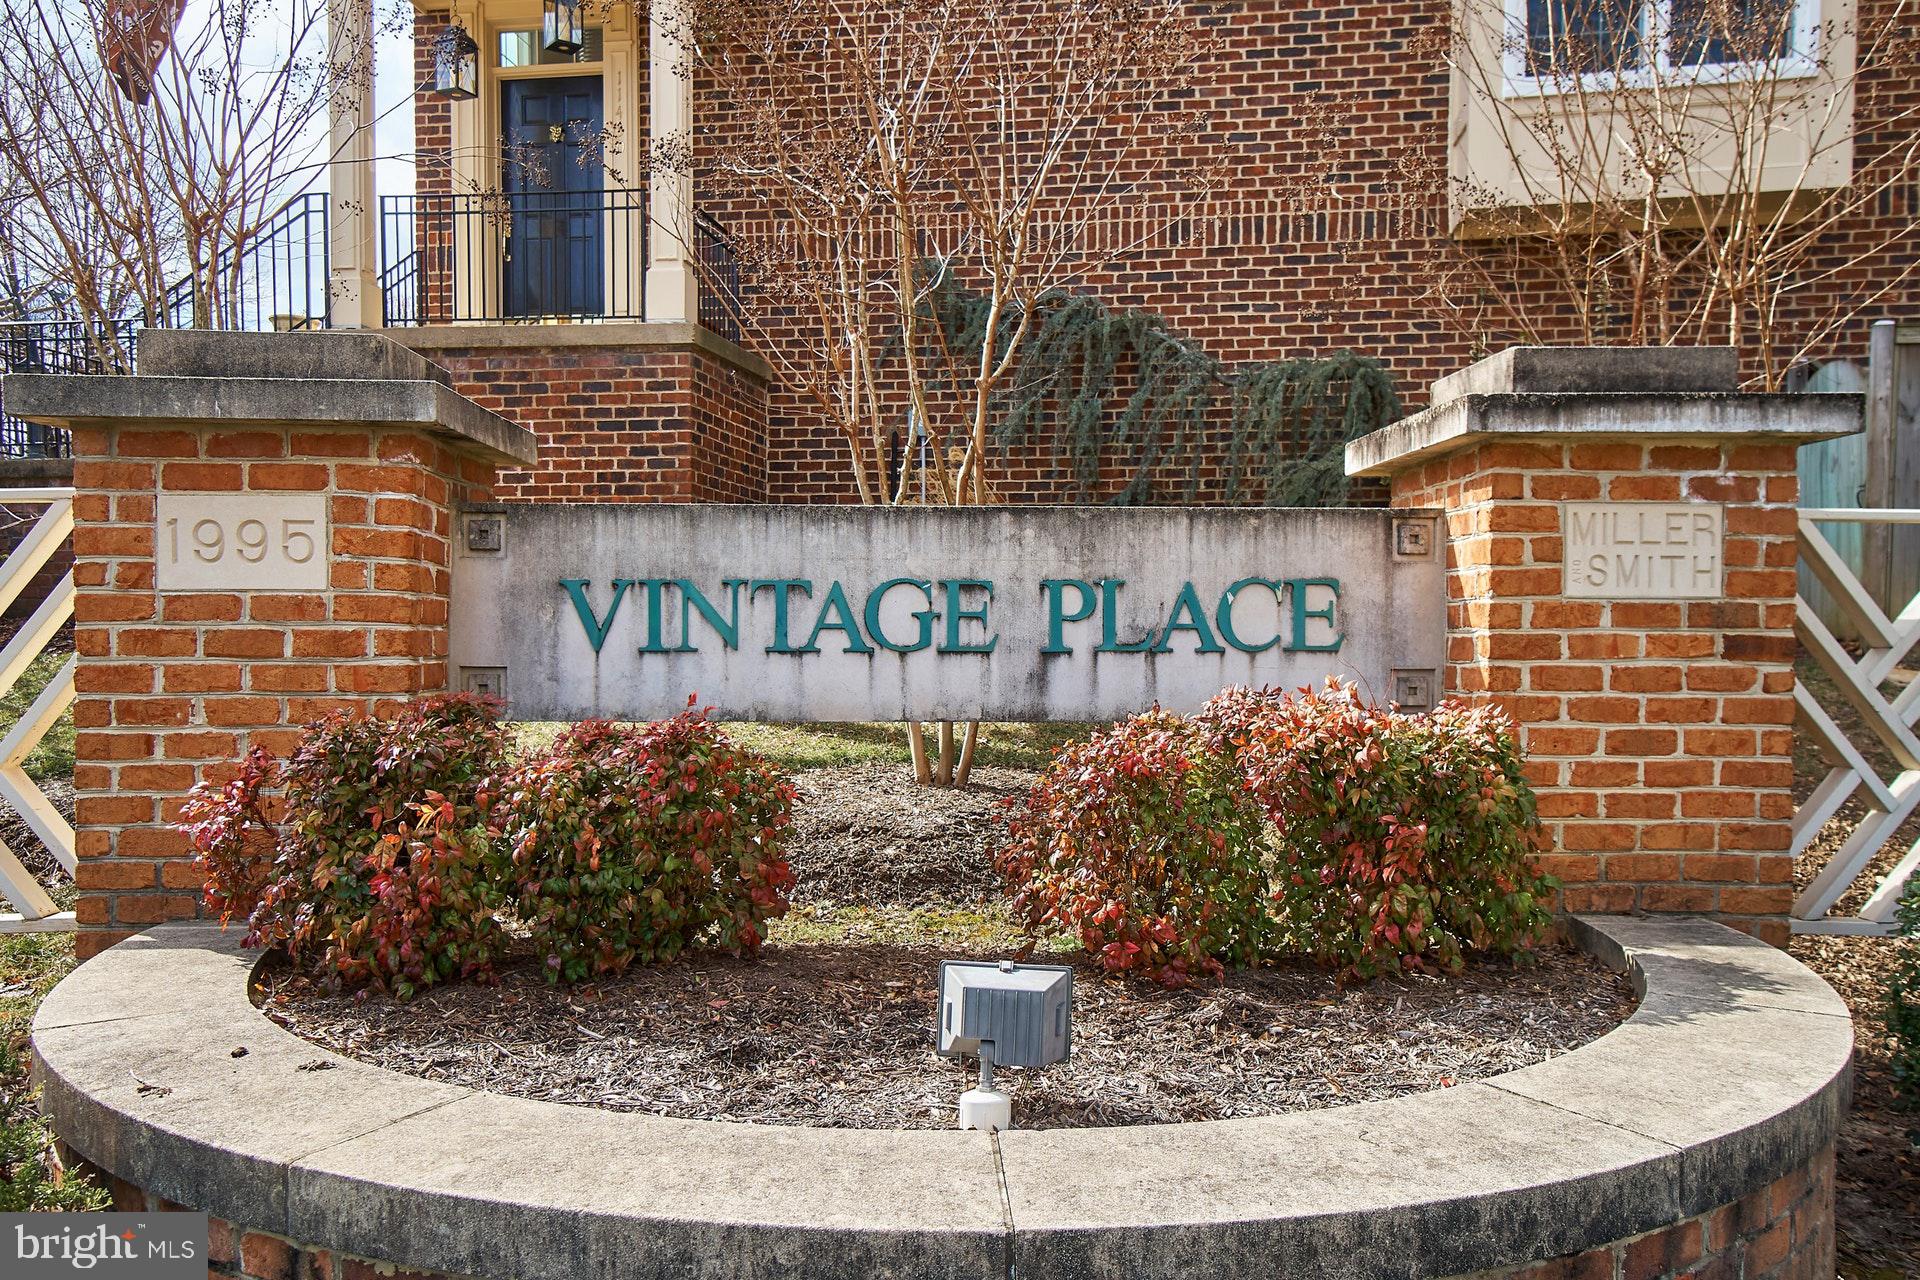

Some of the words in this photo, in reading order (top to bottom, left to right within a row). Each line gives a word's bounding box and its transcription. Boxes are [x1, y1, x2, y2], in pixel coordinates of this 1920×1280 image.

[166, 518, 315, 564] 1995
[1573, 511, 1716, 547] MILLER
[1571, 559, 1582, 585] AND
[1586, 554, 1716, 589] SMITH
[558, 577, 995, 654] VINTAGE
[1039, 576, 1346, 654] PLACE
